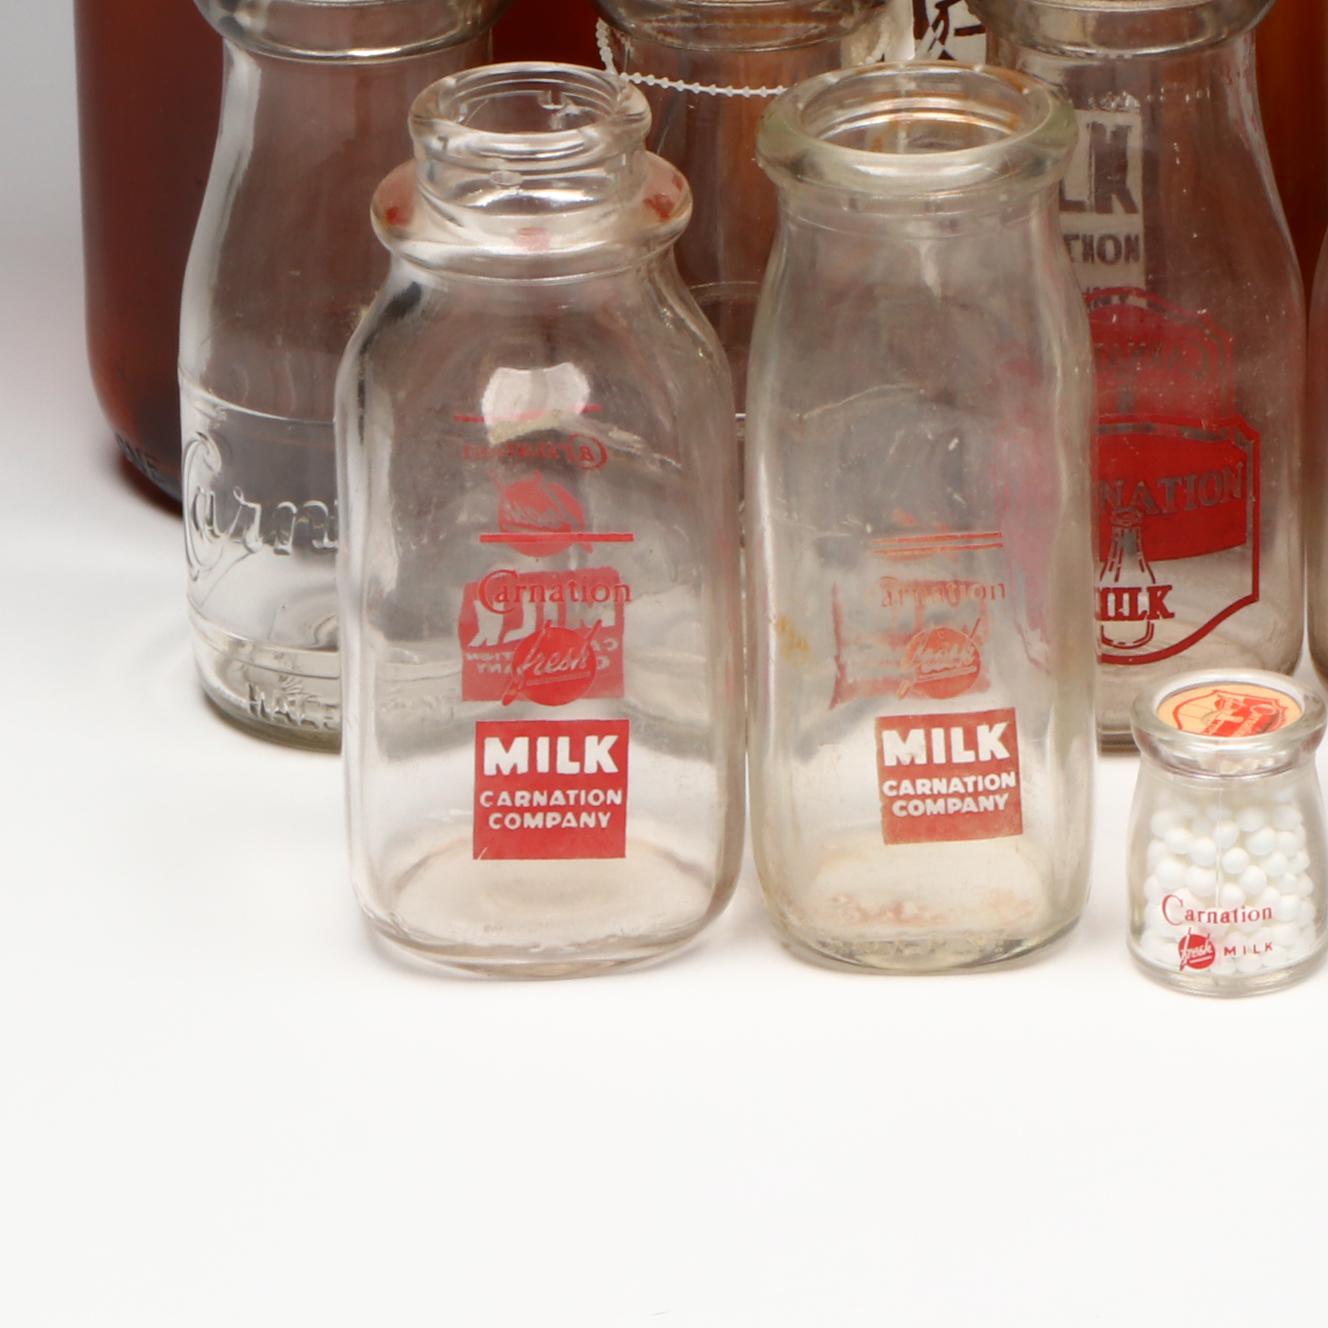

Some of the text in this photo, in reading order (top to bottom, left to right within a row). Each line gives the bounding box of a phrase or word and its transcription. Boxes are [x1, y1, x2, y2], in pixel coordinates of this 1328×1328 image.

[479, 570, 634, 614] Carnation
[483, 734, 620, 777] MILK
[881, 722, 1011, 767] MILK
[480, 788, 623, 808] CARNATION
[882, 771, 1017, 798] CARNATION
[892, 793, 1010, 818] COMPANY
[488, 812, 612, 830] COMPANY
[1161, 893, 1274, 926] Carnation
[1223, 941, 1274, 957] MILK
